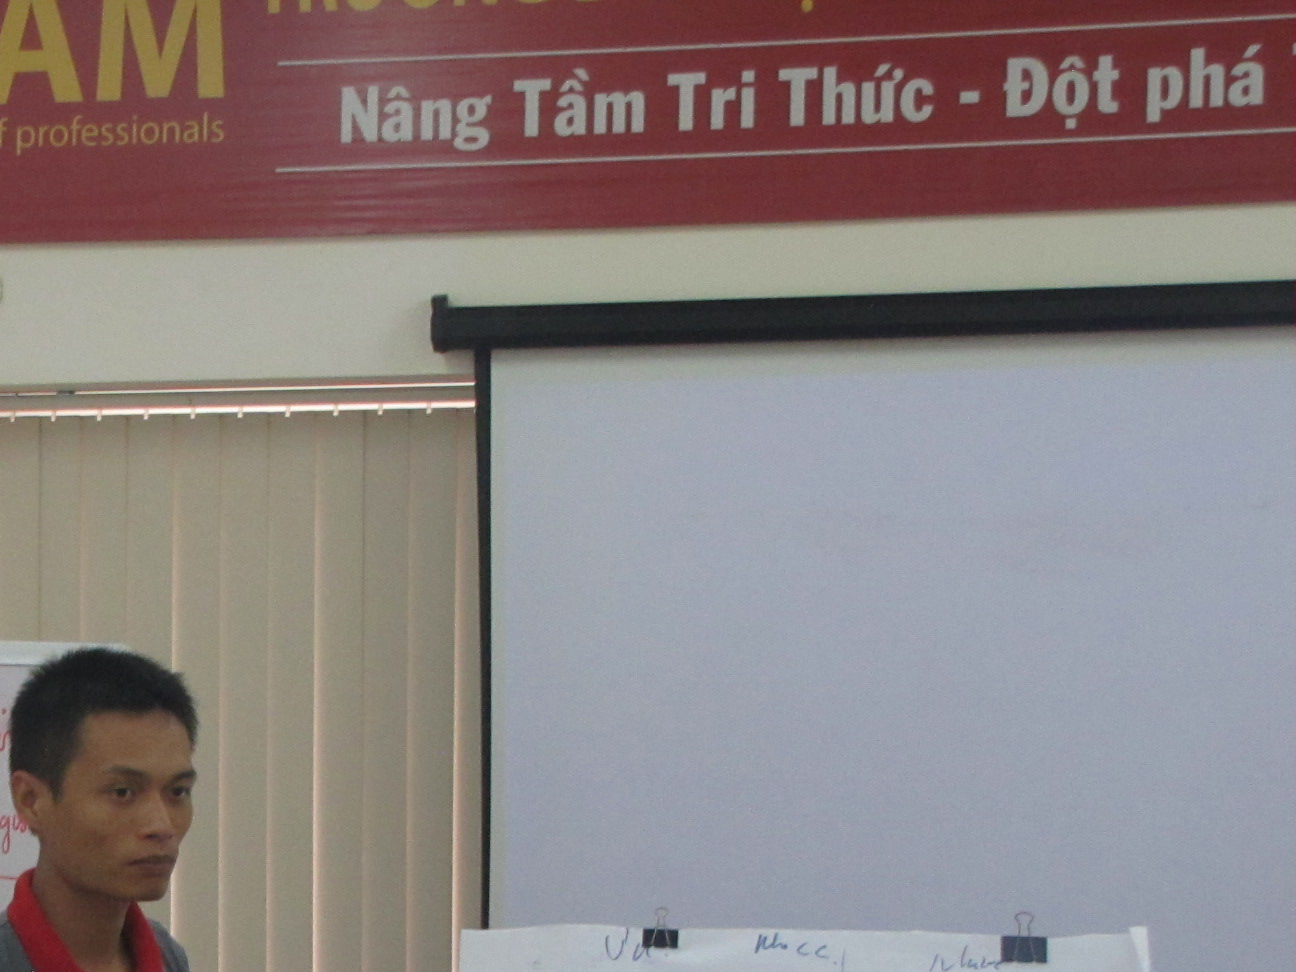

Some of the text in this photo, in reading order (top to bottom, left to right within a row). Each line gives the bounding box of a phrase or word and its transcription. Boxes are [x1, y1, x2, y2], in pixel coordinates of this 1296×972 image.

[15, 112, 225, 155] professionals
[340, 86, 492, 151] Nâng
[513, 66, 645, 138] Tầm
[666, 70, 755, 131] Tri
[778, 62, 934, 127] Thức
[1003, 54, 1120, 130] Đột
[1145, 43, 1265, 124] phá
